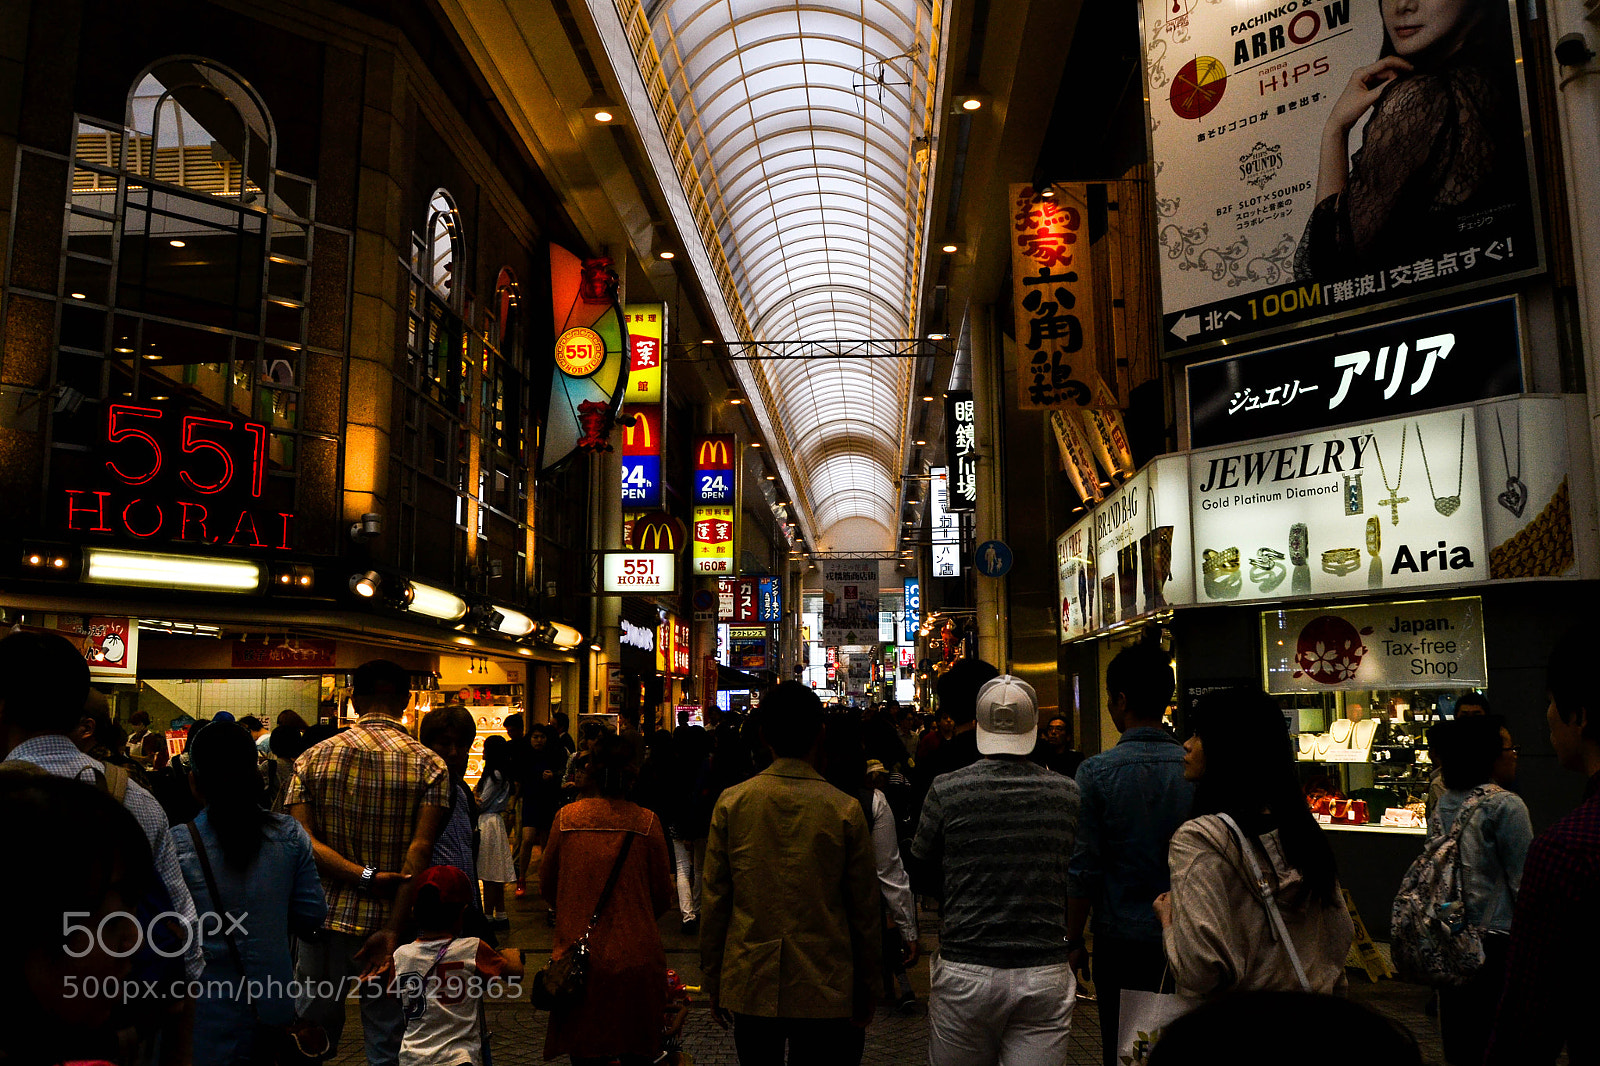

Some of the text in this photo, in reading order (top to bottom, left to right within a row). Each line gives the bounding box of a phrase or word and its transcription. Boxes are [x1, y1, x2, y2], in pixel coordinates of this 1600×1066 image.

[1230, 0, 1298, 37] PACHINKO
[1233, 0, 1350, 67] ARROW
[1239, 152, 1284, 181] SOUNDS
[1216, 204, 1233, 217] B2F
[1235, 198, 1293, 222] スロットと音楽の
[1236, 208, 1293, 231] コラボレーション
[1204, 310, 1243, 332] 北へ
[1247, 283, 1322, 321] 100M
[566, 344, 593, 360] 551
[565, 363, 595, 374] HORAI
[1328, 332, 1456, 410] アリア
[1227, 379, 1319, 415] ジュエリー
[105, 403, 267, 498] 551
[1199, 433, 1374, 493] JEWELRY
[701, 475, 729, 493] 24h
[701, 491, 725, 499] OPEN
[1201, 481, 1340, 510] Gold Platinum Diamond
[65, 489, 295, 551] HORAI
[696, 508, 730, 516] 中国料理
[1097, 501, 1121, 541] BRAND
[1121, 486, 1138, 524] BAG
[700, 545, 726, 553] 本館
[1058, 539, 1069, 567] TAX
[1069, 528, 1083, 558] FREE
[1390, 540, 1475, 575] Aria
[624, 559, 654, 575] 551
[699, 561, 727, 572] 160席
[617, 575, 660, 585] HORAI
[740, 582, 752, 620] ガスト
[771, 578, 780, 620] インターネット
[1389, 616, 1454, 635] Japan.
[1381, 638, 1457, 656] Tax-free
[1410, 658, 1458, 678] Shop
